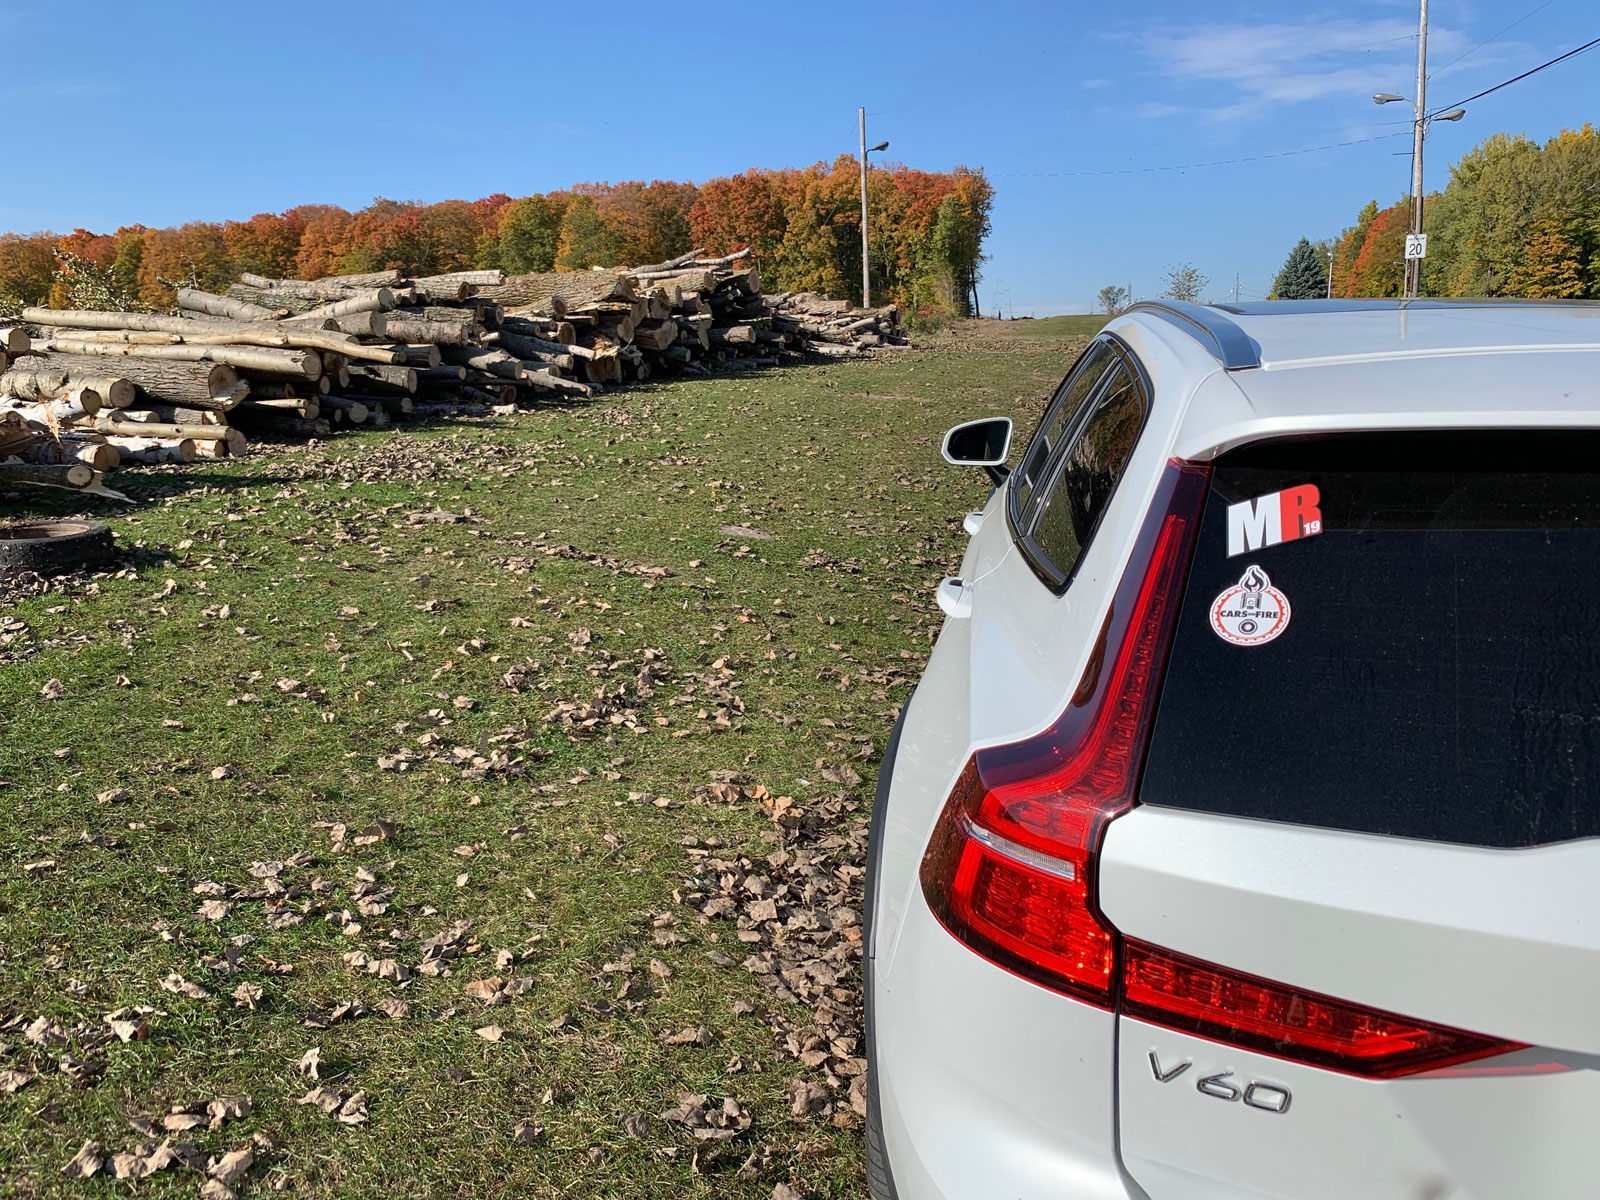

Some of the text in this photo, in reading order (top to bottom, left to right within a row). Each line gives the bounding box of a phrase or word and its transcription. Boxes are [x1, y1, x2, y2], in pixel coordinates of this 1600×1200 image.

[1409, 243, 1422, 255] 20
[1228, 484, 1321, 557] MR
[1303, 520, 1320, 535] 19
[1220, 610, 1248, 618] CARS
[1255, 611, 1279, 619] FIRE
